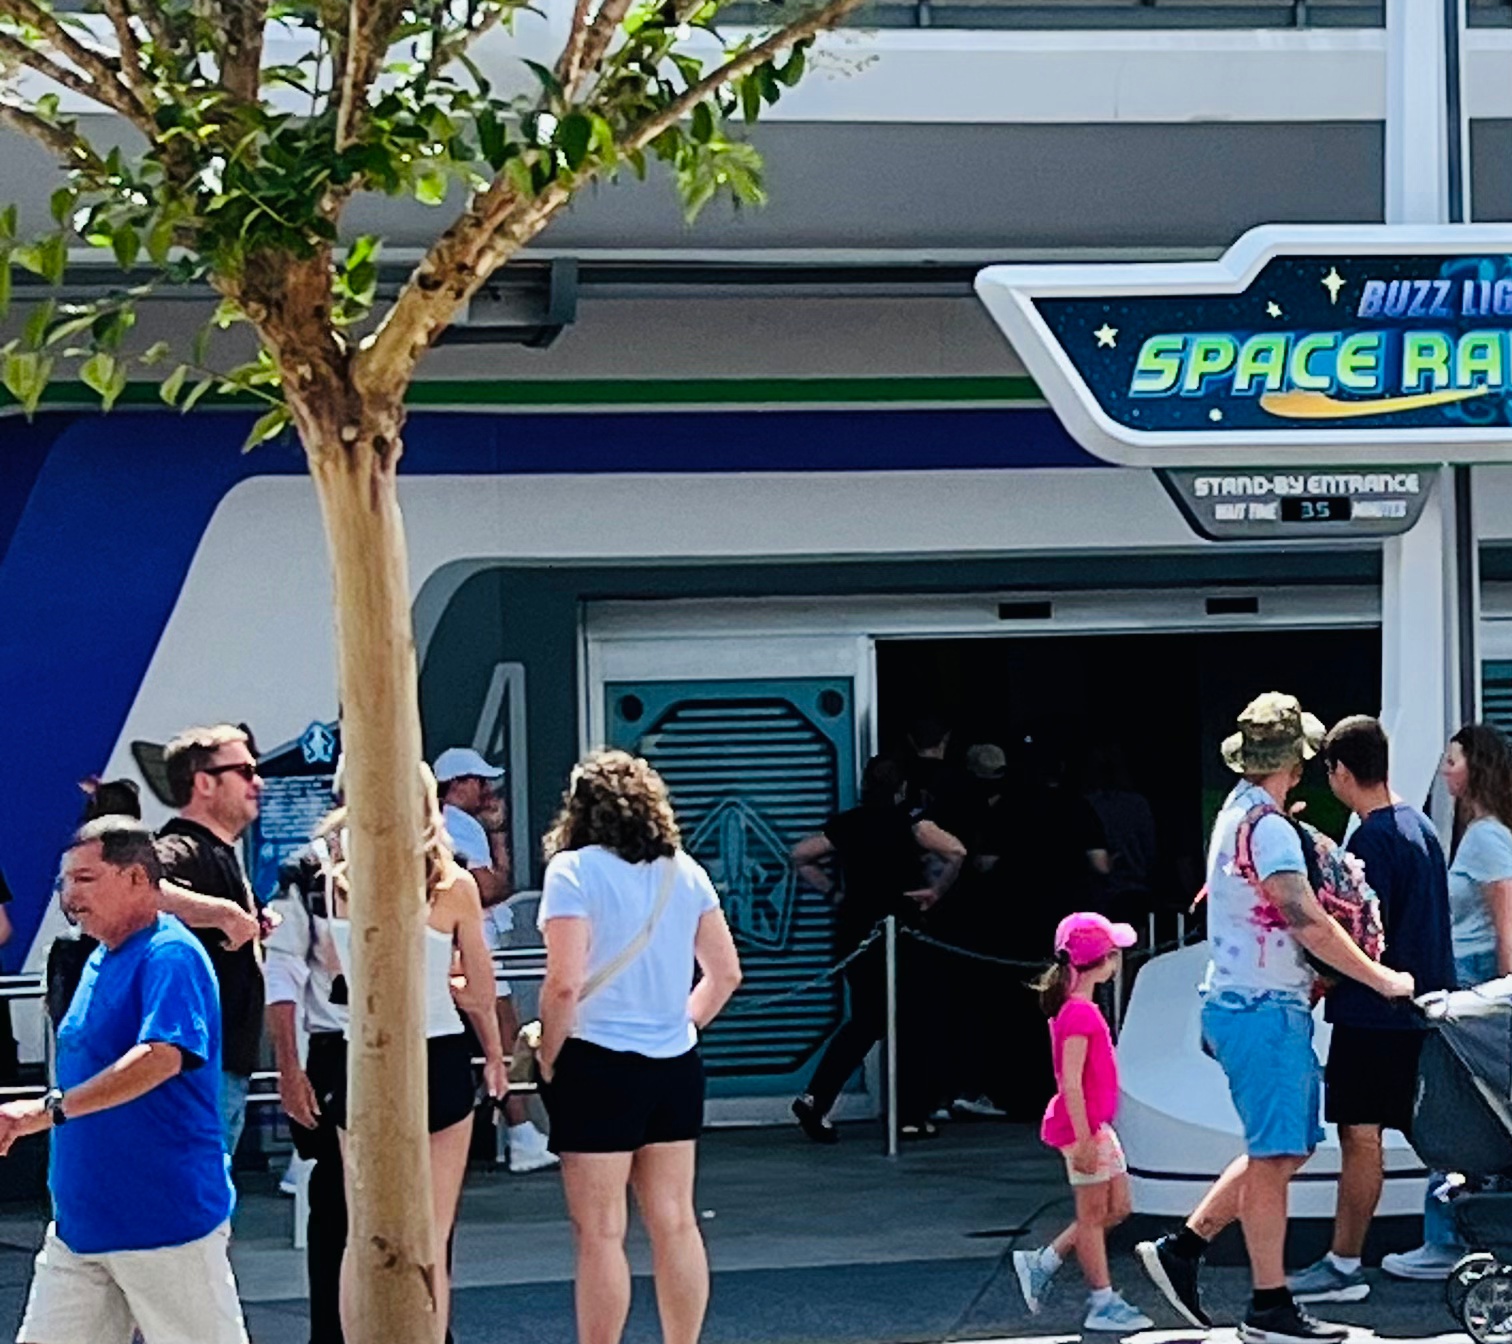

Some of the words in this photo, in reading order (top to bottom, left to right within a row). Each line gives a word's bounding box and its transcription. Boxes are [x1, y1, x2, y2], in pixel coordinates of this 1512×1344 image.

[1357, 279, 1452, 318] BUZZ
[1129, 330, 1385, 397] SPACE
[1194, 476, 1304, 497] STAND-BY
[1306, 473, 1420, 495] ENTRANCE
